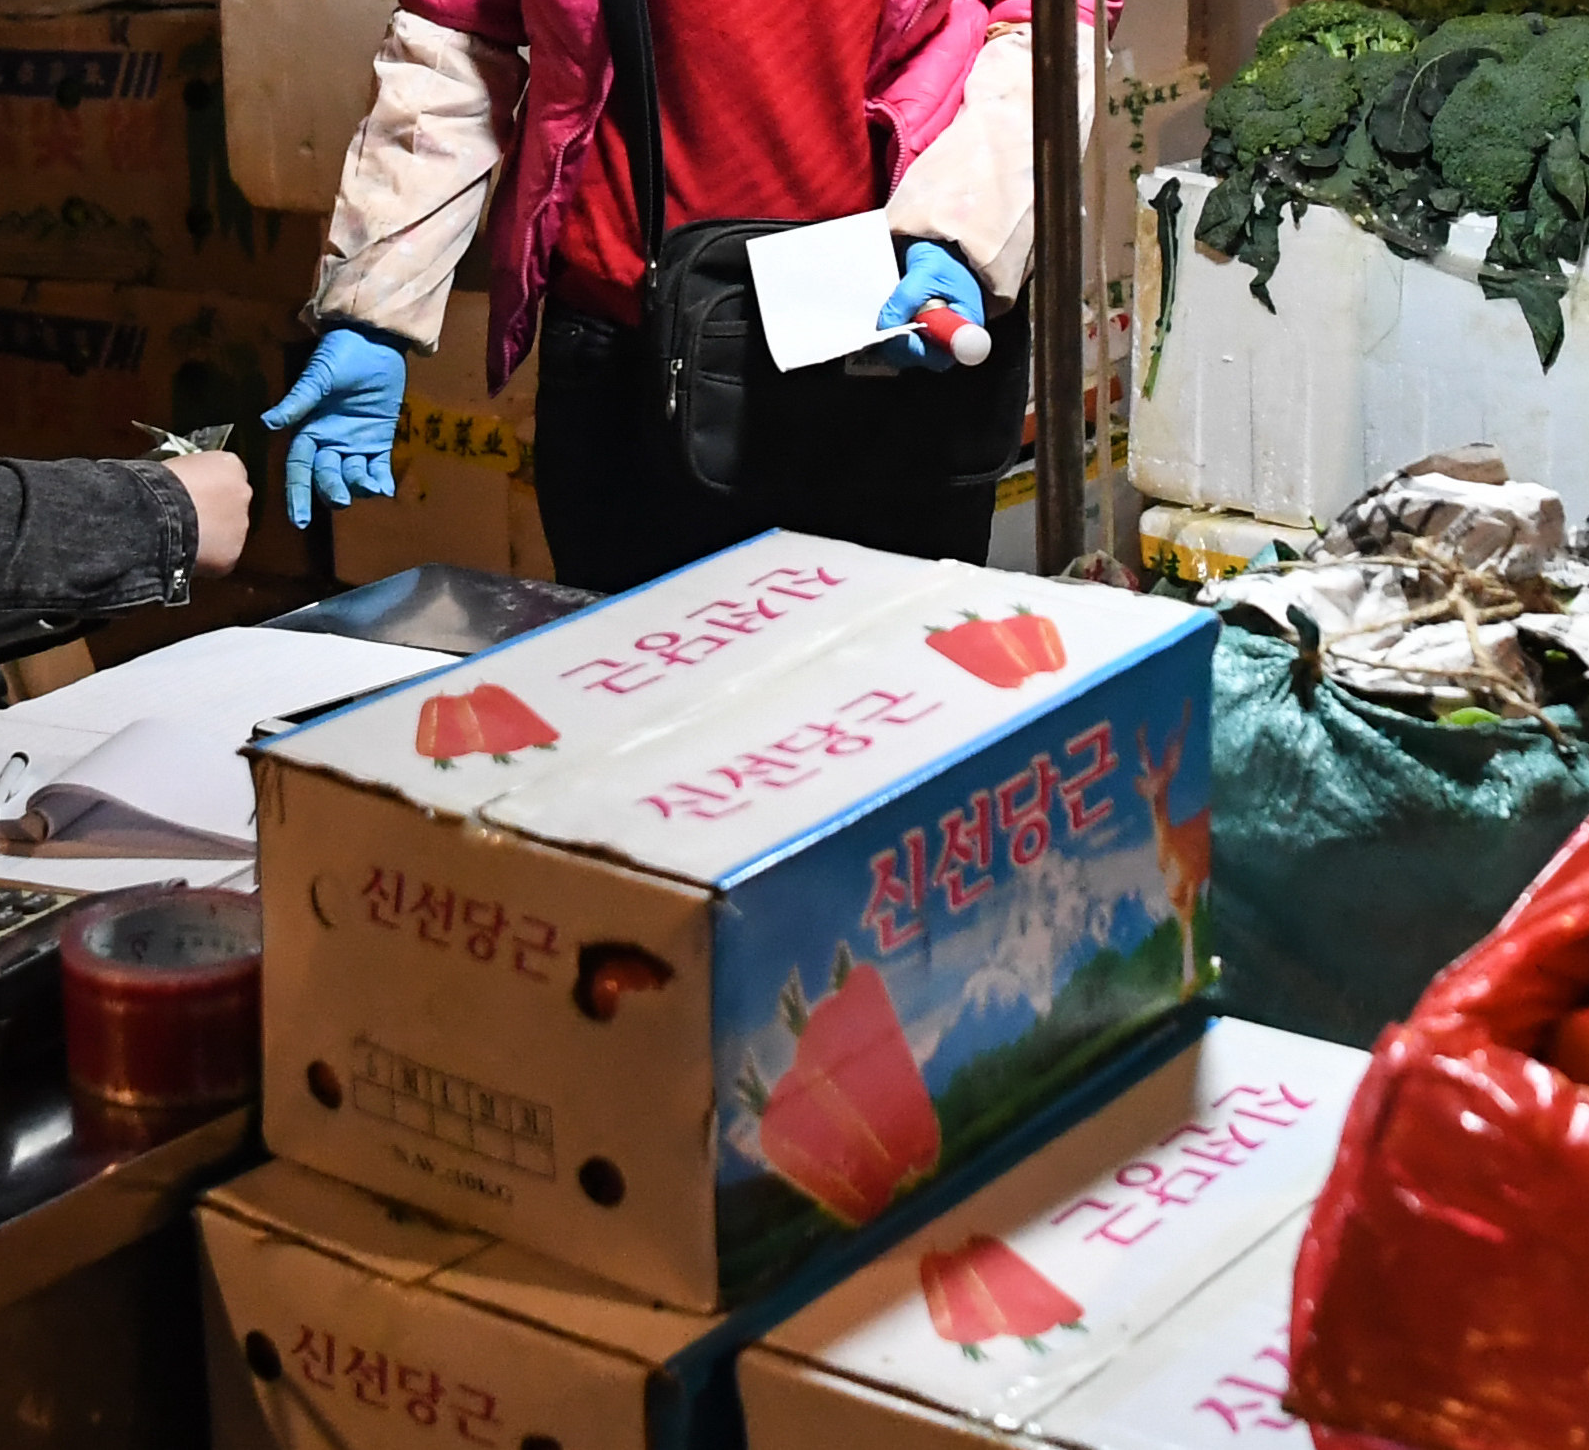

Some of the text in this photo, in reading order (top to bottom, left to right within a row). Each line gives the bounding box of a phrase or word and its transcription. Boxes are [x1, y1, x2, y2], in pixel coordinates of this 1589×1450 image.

[558, 566, 848, 695] 신선당근
[636, 688, 945, 822] 신선당근
[859, 715, 1120, 955] 신선당근
[361, 866, 562, 985] 신선당근
[1050, 1082, 1316, 1246] 신선당근
[291, 1324, 501, 1448] 신선당근
